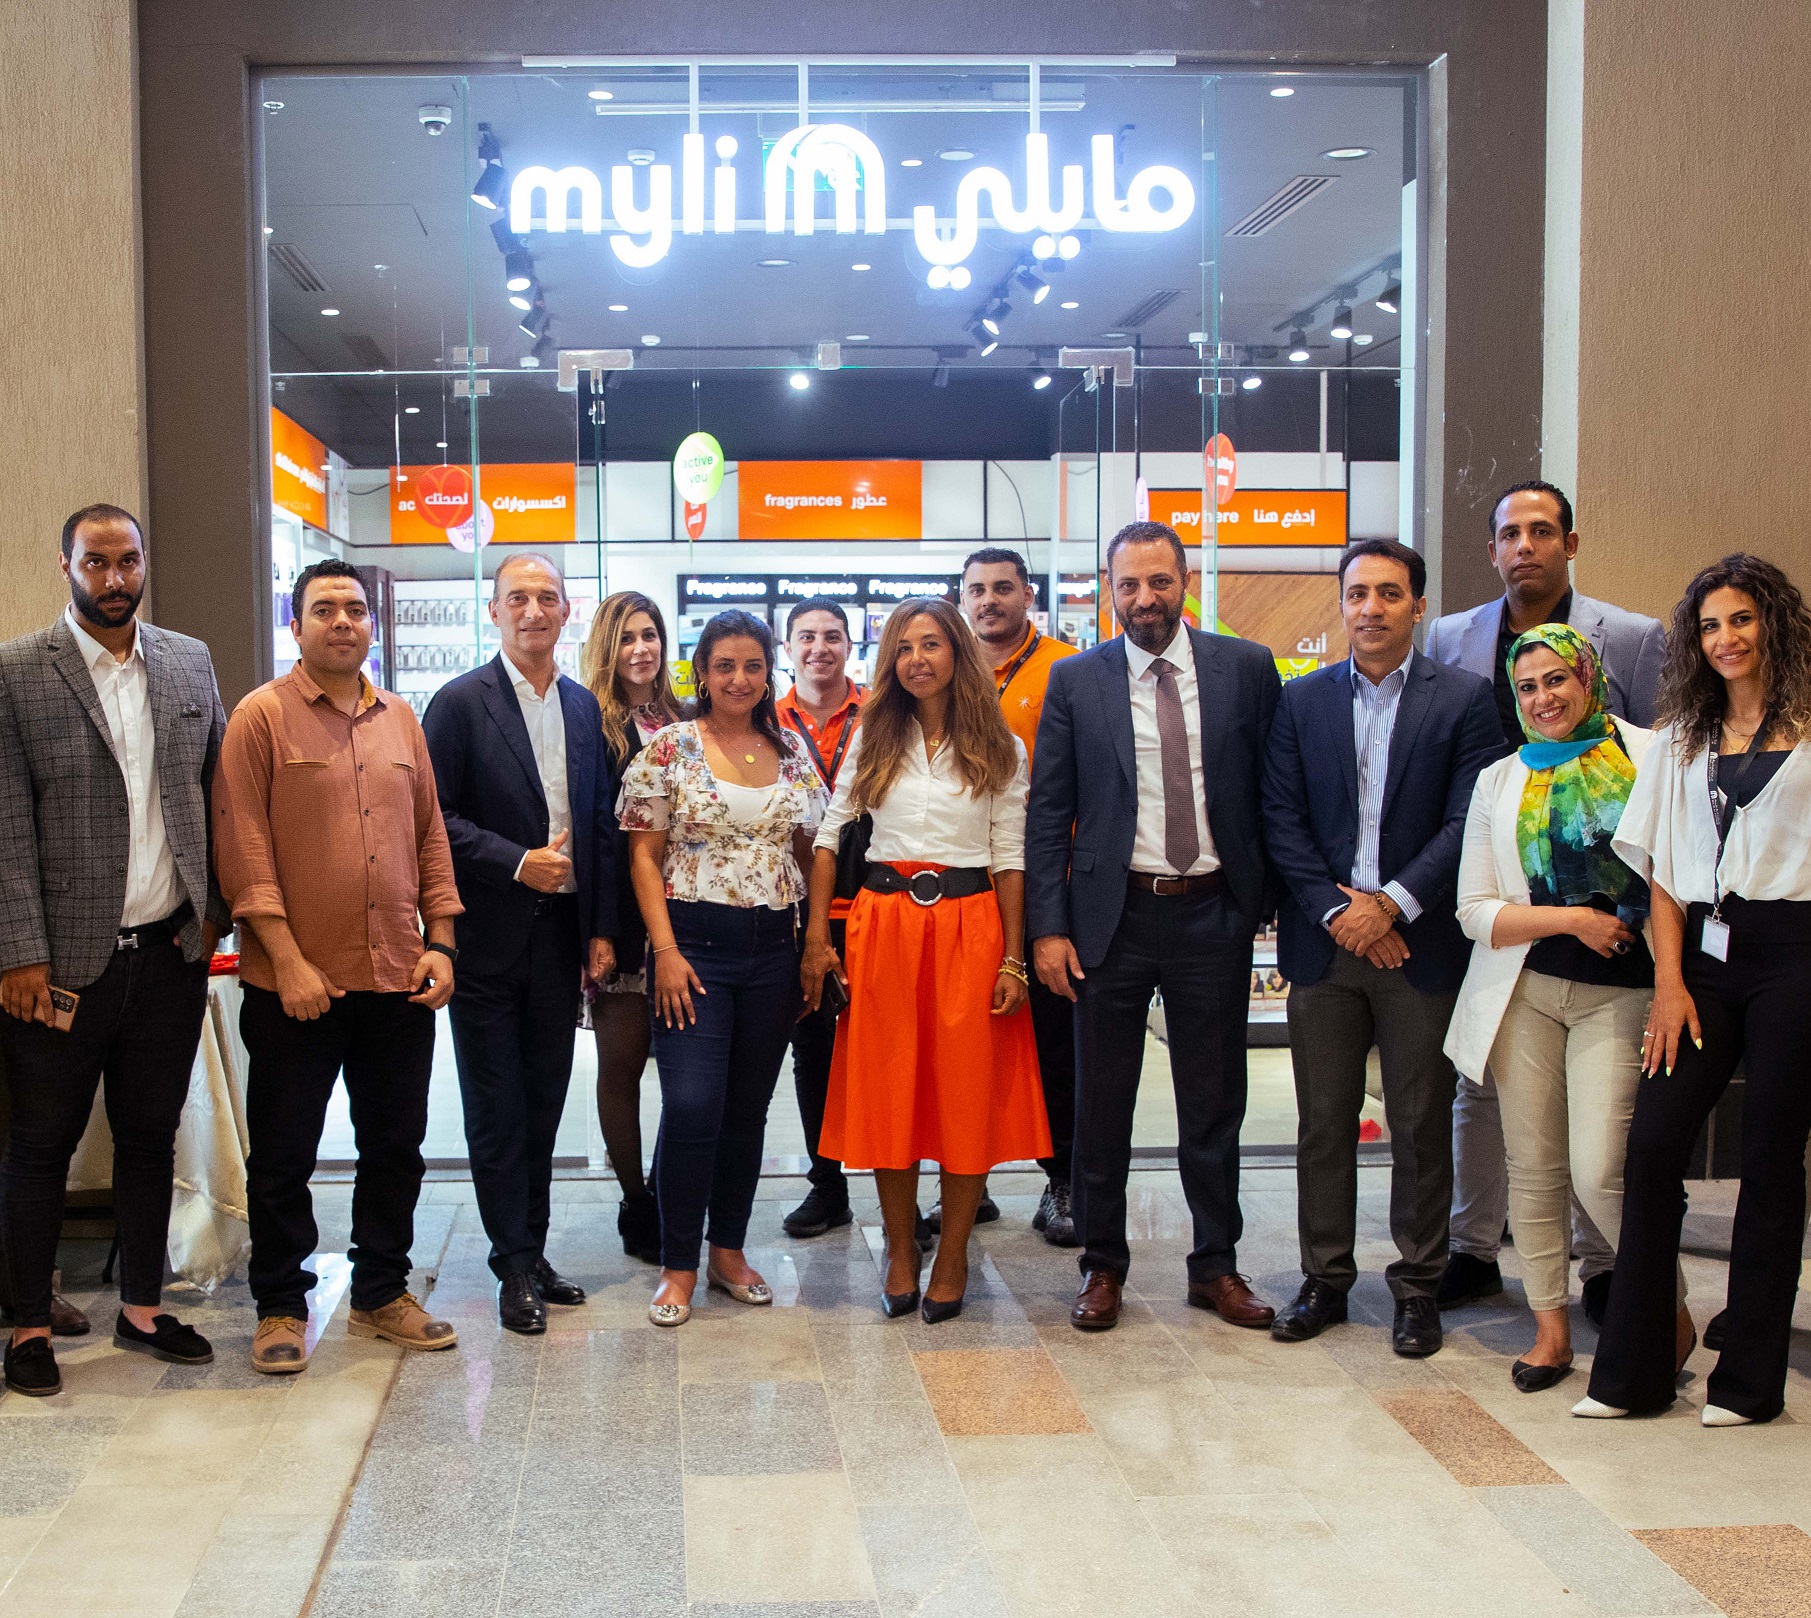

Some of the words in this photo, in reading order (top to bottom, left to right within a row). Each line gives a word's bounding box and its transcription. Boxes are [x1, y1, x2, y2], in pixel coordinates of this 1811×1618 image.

[510, 133, 738, 268] myli
[913, 132, 1196, 289] مايلي
[764, 493, 842, 510] fragrances
[850, 493, 888, 510] عطور
[1171, 511, 1200, 526] pay
[1253, 509, 1278, 524] هنا
[1281, 508, 1316, 529] إدفع
[1296, 631, 1328, 654] أنت
